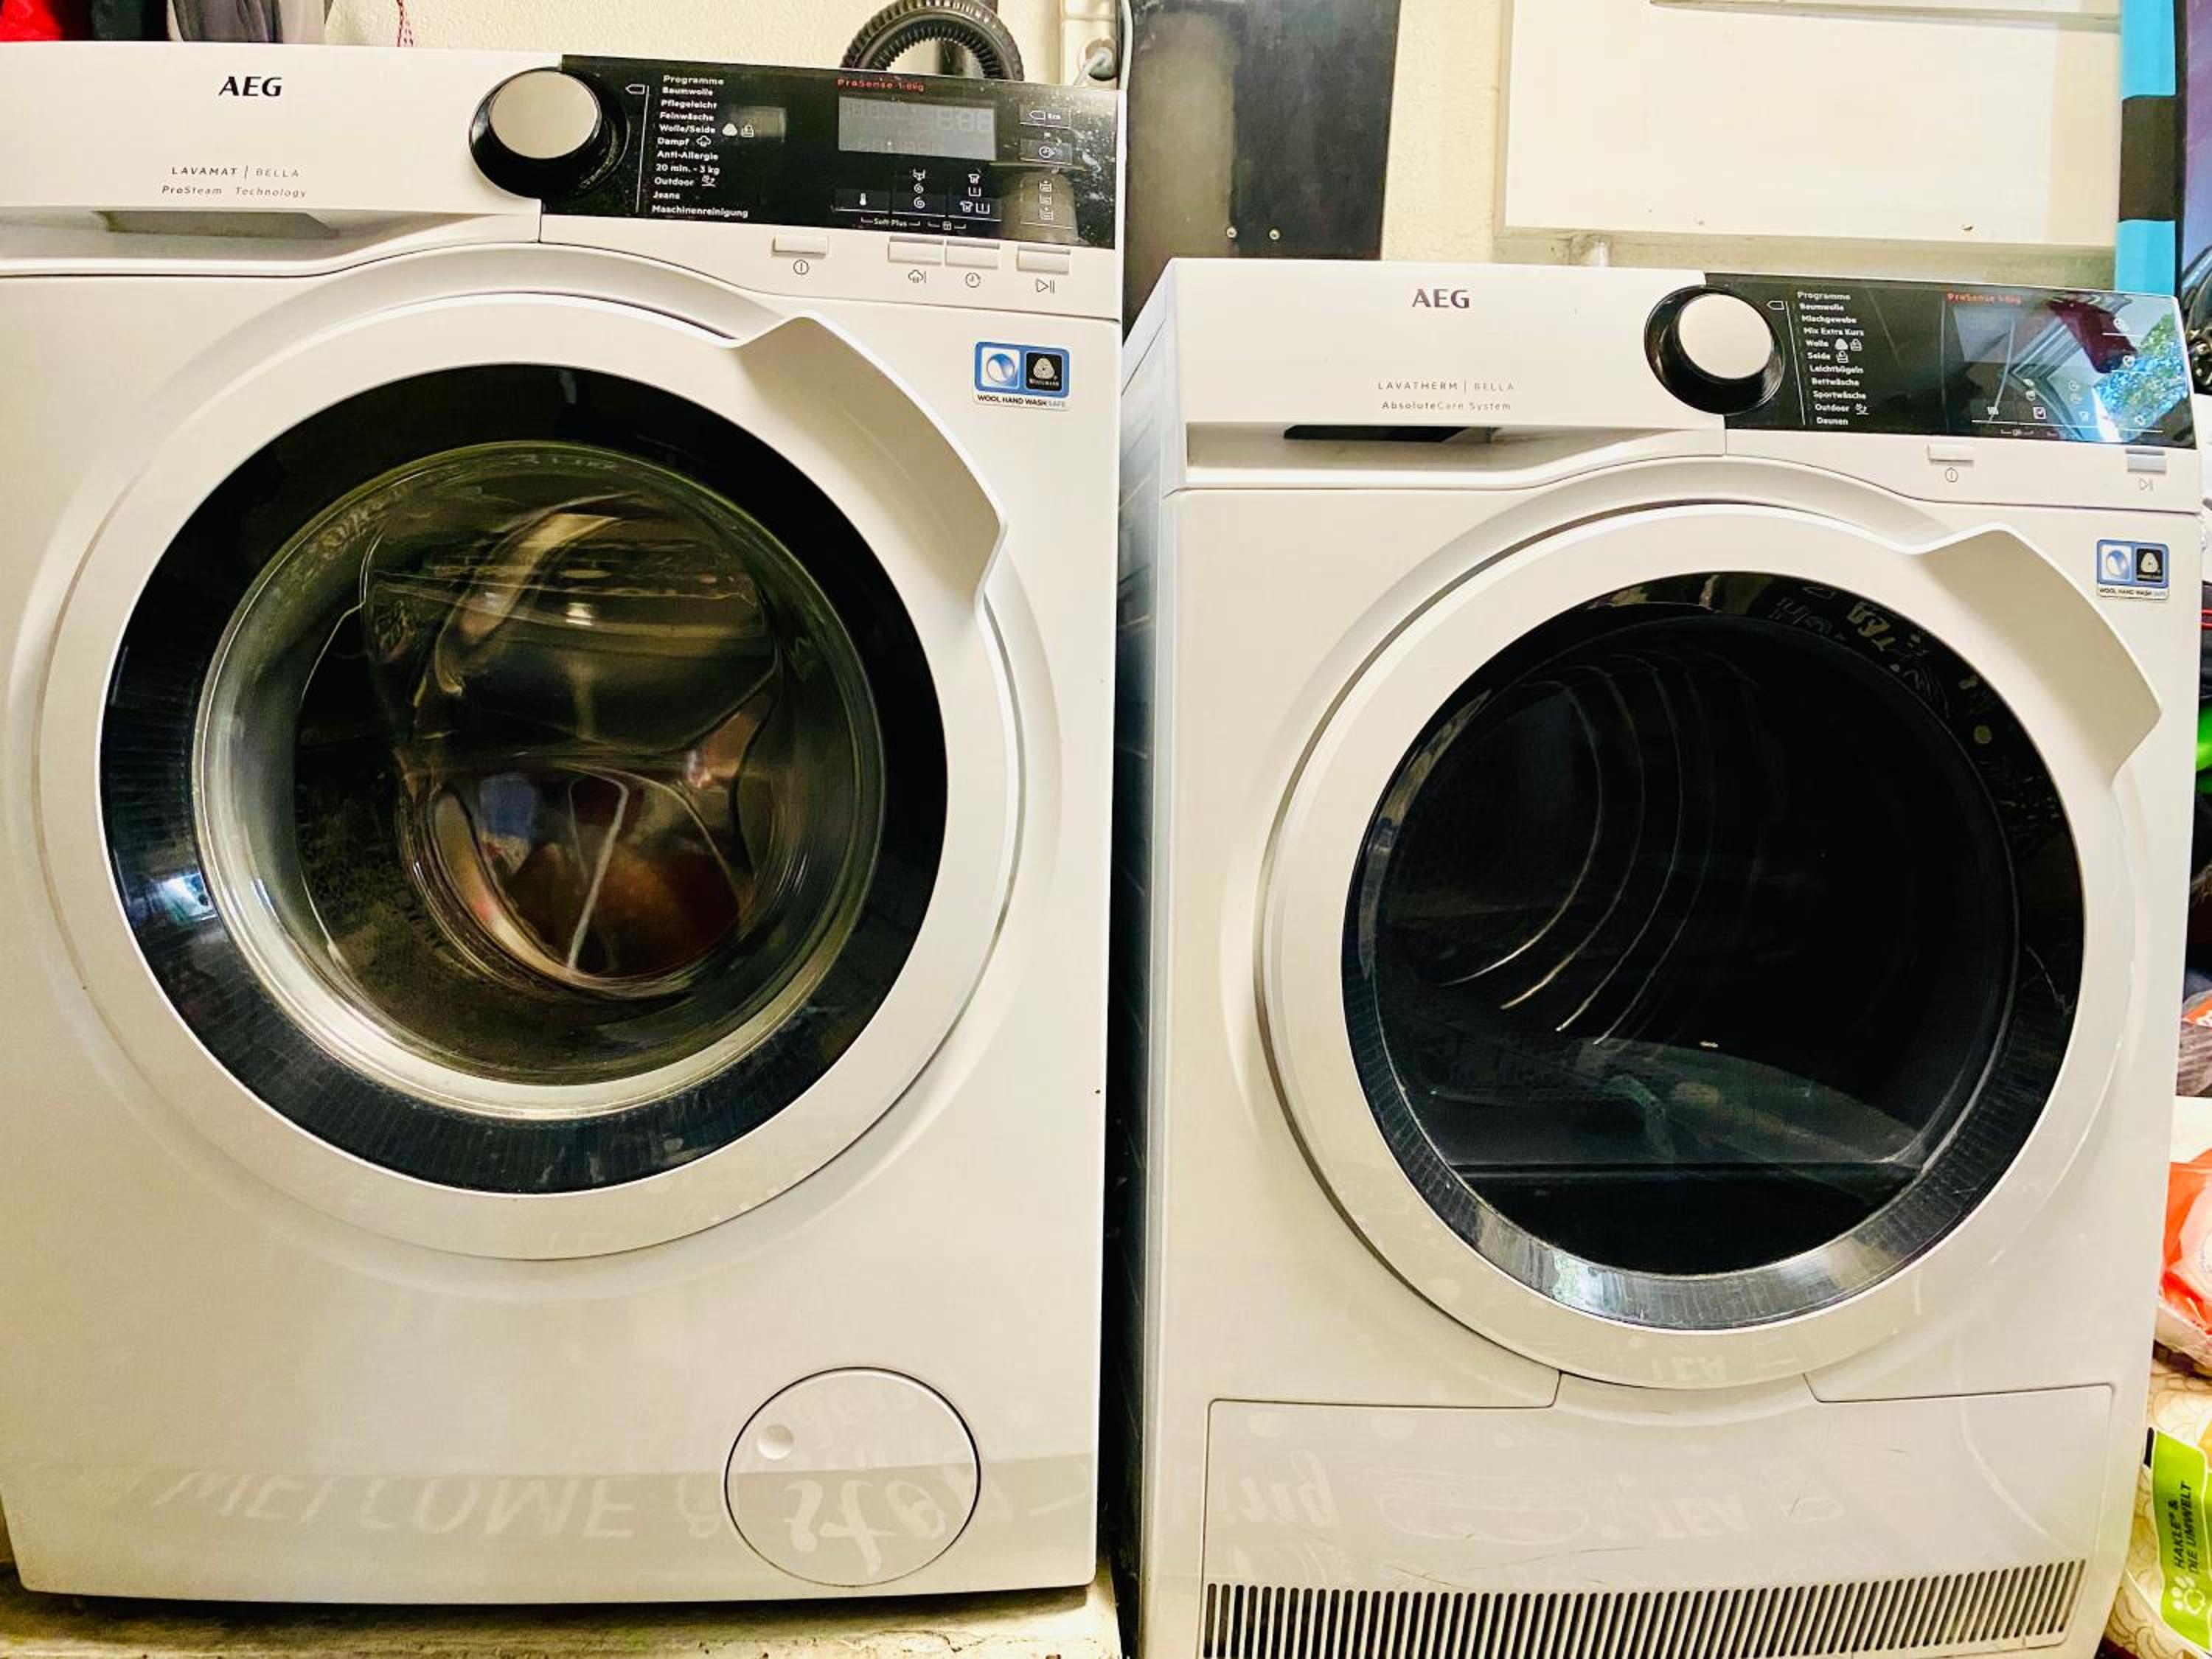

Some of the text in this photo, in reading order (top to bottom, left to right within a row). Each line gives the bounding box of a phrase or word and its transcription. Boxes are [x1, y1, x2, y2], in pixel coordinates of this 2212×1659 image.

[663, 74, 725, 86] Programme
[218, 75, 283, 97] AEG
[662, 86, 714, 96] Baumwolle
[661, 99, 718, 110] Pflegeleicht
[659, 111, 714, 122] Feinwäsche
[658, 124, 716, 134] Wolle/Seide
[657, 137, 689, 147] Dampf
[656, 150, 719, 161] Anti-Allergie
[171, 167, 238, 176] LAVAMAT
[255, 167, 300, 178] BELLA
[655, 163, 669, 172] 20
[670, 164, 691, 173] min.
[700, 165, 706, 173] 3
[708, 166, 720, 175] kg
[654, 177, 695, 187] Outdoor
[161, 185, 307, 199] ProSteam Technology
[653, 190, 681, 200] Jeans
[652, 204, 749, 219] Maschinenreinigung
[1412, 288, 1470, 309] AEG
[1797, 291, 1851, 301] Programme
[1800, 303, 1844, 311] Baumwolle
[1801, 315, 1857, 324] Mischgewebe
[1804, 327, 1819, 335] Mix
[1821, 327, 1843, 335] Extra
[1805, 339, 1829, 347] Wolle
[1809, 365, 1864, 375] Leichtbügeln
[1377, 381, 1458, 391] LAVATHERM
[1474, 383, 1514, 392] BELLA
[1812, 377, 1860, 386] Bettwäsche
[977, 394, 1001, 403] WOOL
[1002, 396, 1024, 405] HAND
[1024, 398, 1047, 406] WASH
[1812, 391, 1867, 400] Sportwäsche
[1381, 401, 1511, 411] AbsoluteCare System
[1815, 403, 1849, 412] Outdoor
[1816, 417, 1848, 425] Daunen
